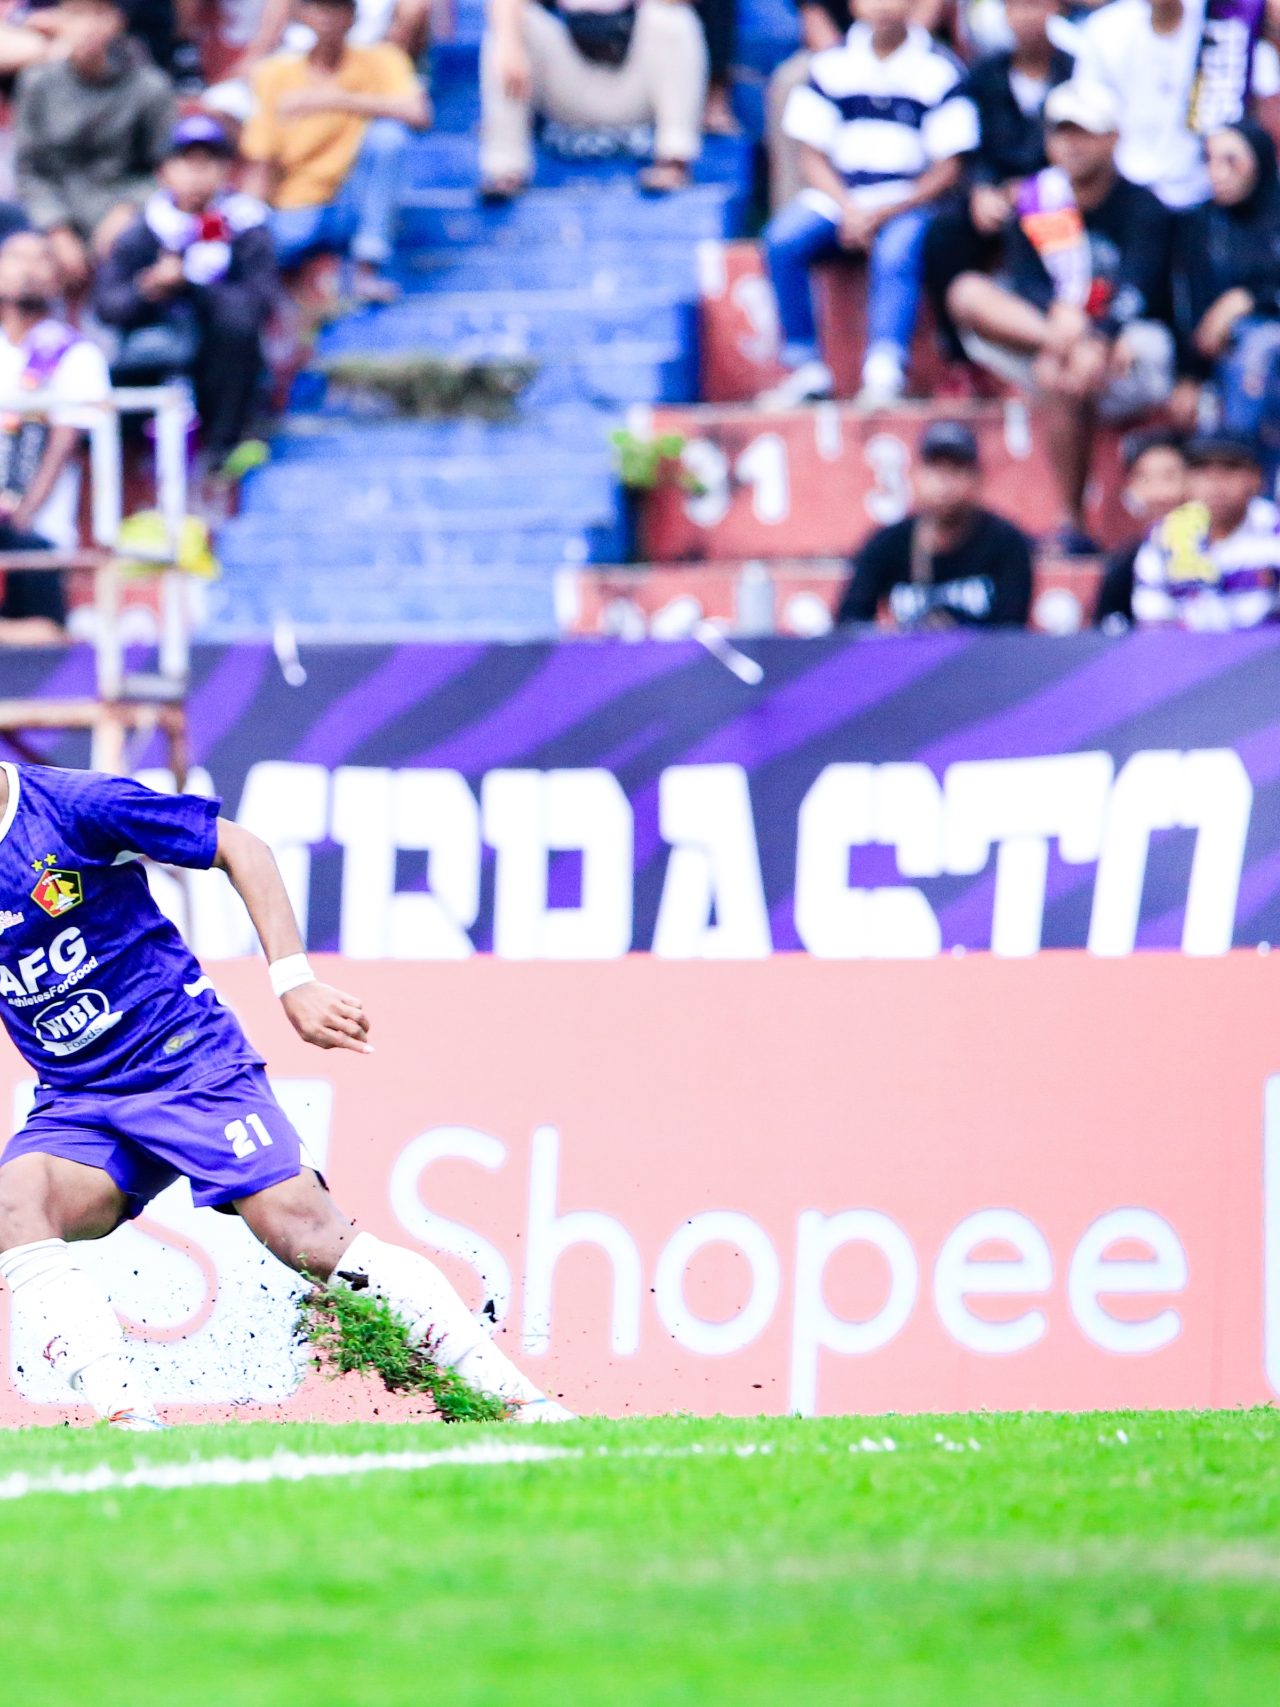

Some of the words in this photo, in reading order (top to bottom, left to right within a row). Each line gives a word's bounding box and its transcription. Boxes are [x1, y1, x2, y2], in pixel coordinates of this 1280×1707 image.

[39, 995, 100, 1040] WBI
[63, 1026, 103, 1052] Foods
[224, 1111, 274, 1159] 21
[388, 1122, 1190, 1419] Shopee
